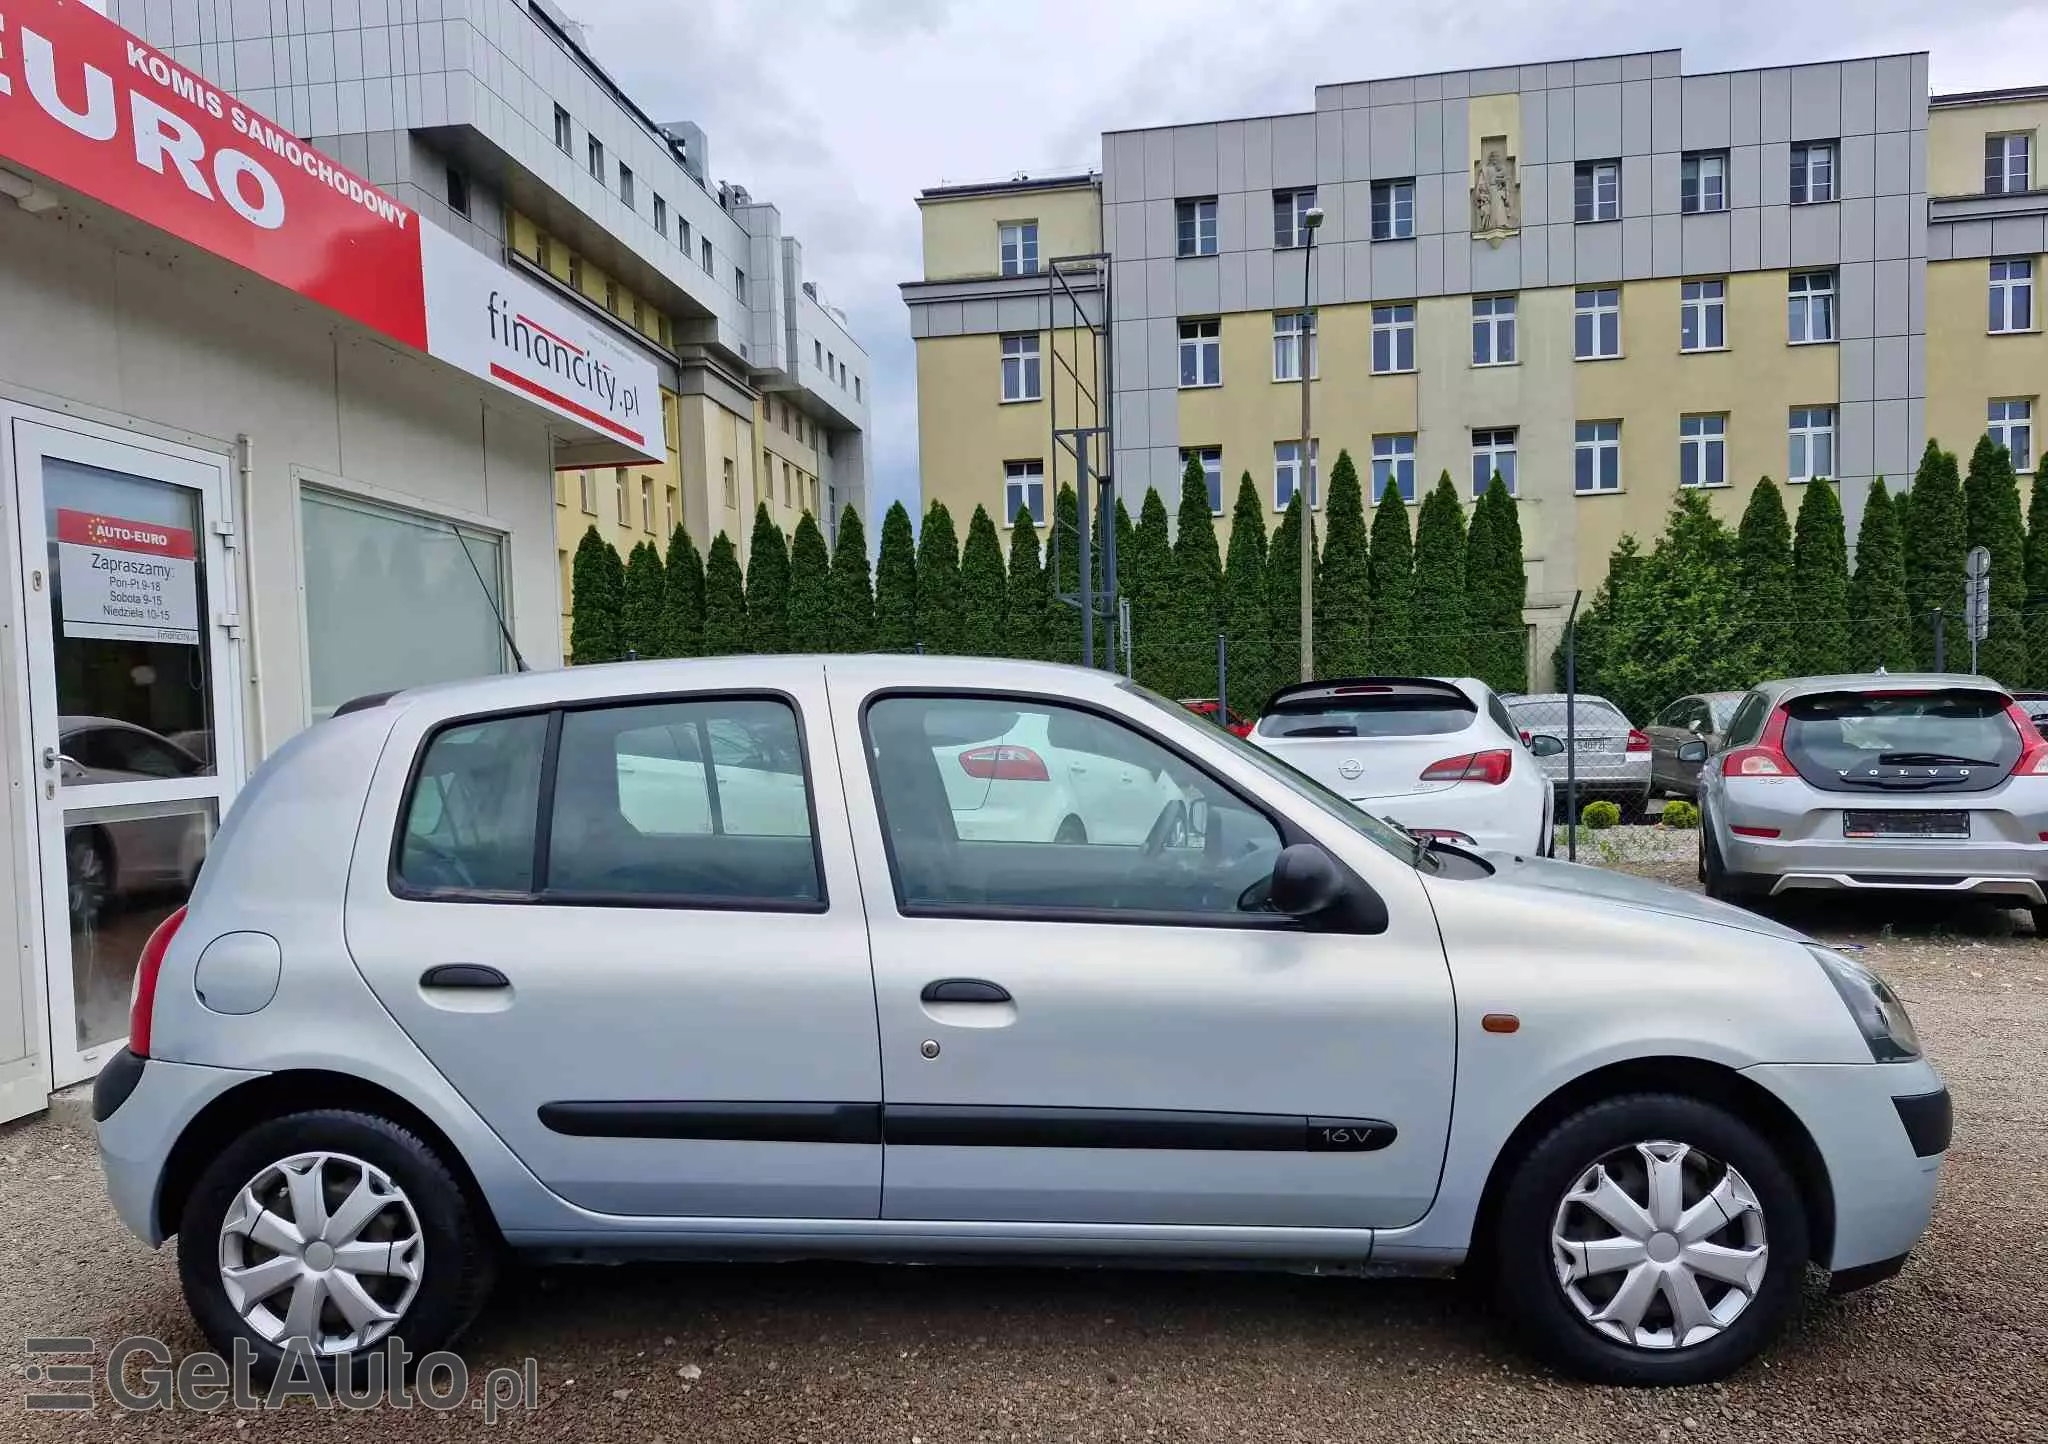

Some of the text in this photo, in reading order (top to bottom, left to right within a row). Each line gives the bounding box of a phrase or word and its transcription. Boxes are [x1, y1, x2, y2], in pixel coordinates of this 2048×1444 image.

[127, 39, 407, 230] KOMIS SAMOCHODOWY
[487, 291, 639, 417] financity.pl
[96, 525, 168, 546] AUTO-EURO
[1838, 768, 1971, 777] VOLVO
[1321, 1128, 1373, 1143] 16V
